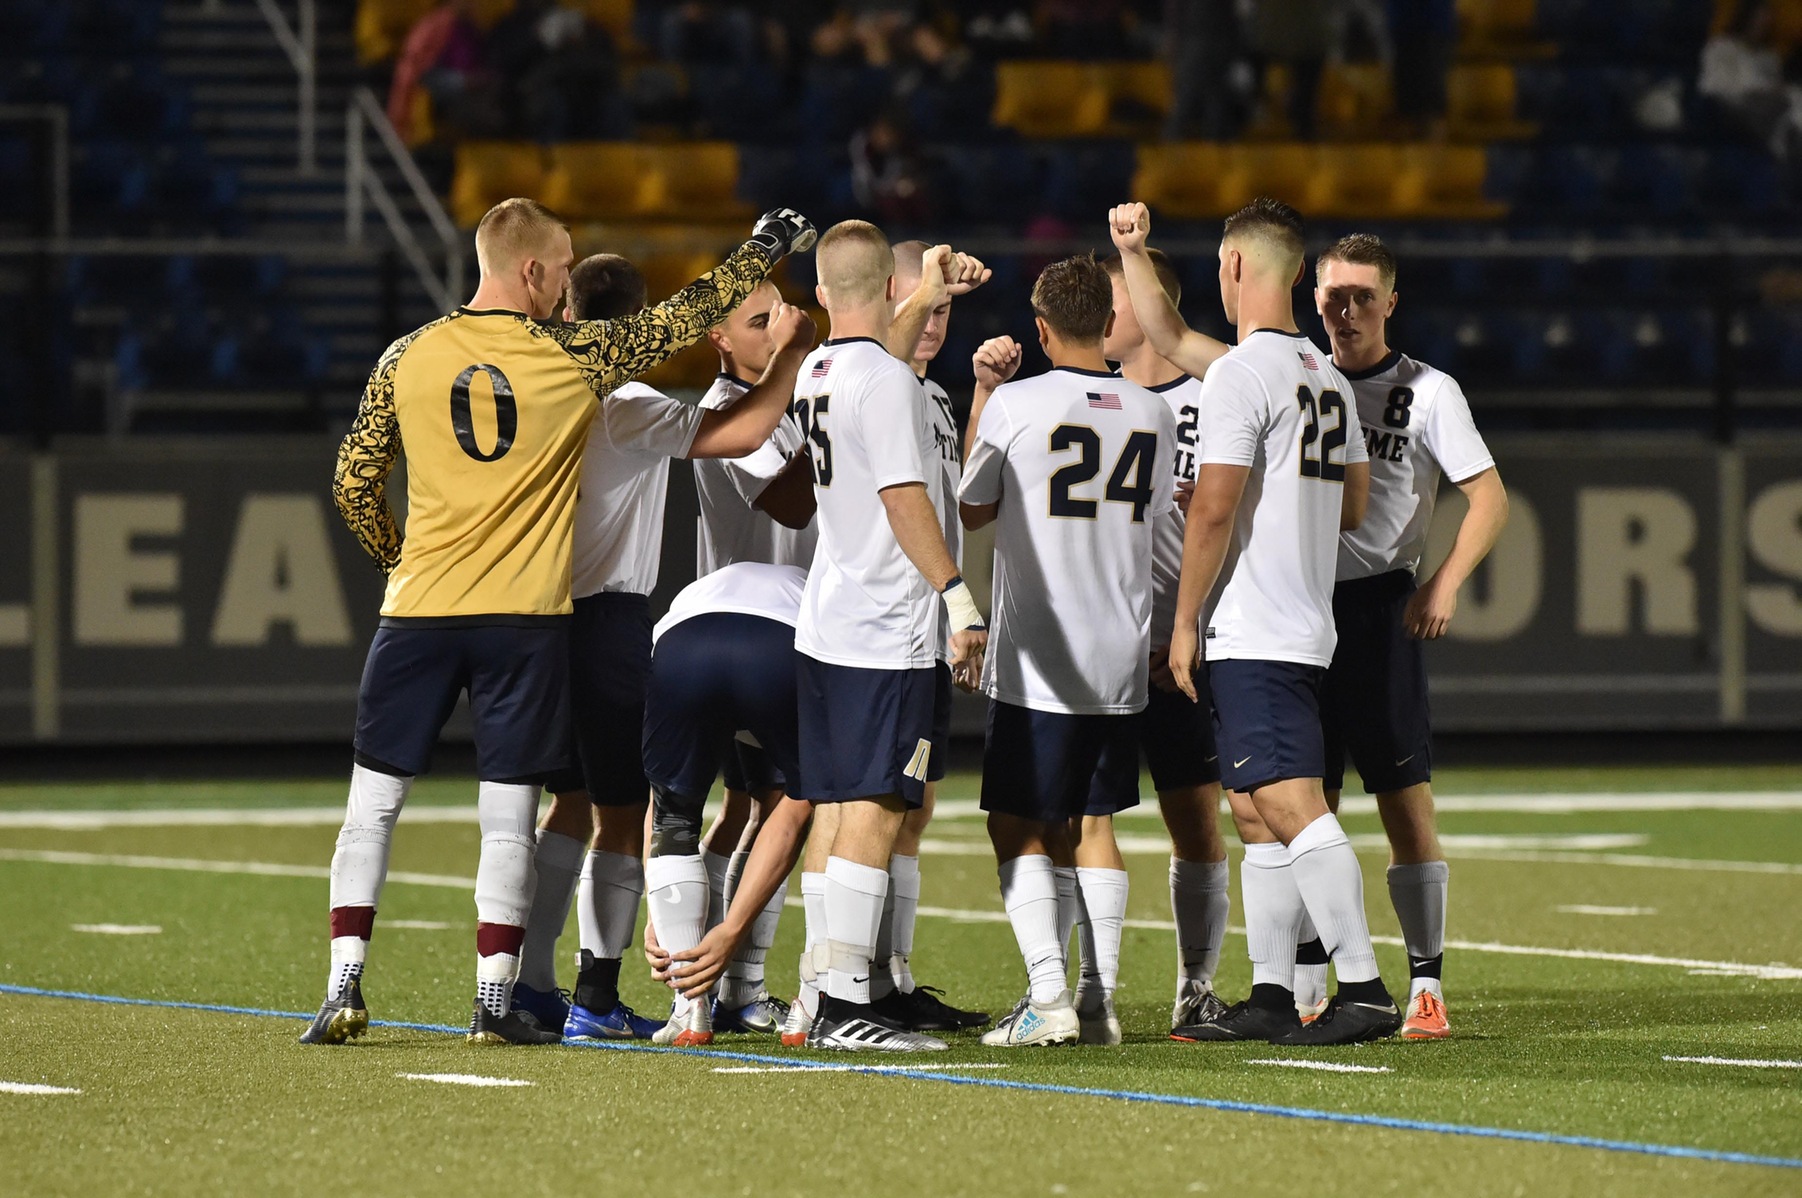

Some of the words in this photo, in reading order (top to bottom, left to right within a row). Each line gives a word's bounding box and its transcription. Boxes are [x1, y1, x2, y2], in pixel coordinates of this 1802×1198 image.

[450, 363, 518, 463] 0
[1176, 404, 1200, 447] 2
[1296, 381, 1347, 485] 22
[1382, 385, 1415, 430] 8
[1047, 421, 1159, 525] 24
[1015, 1016, 1047, 1041] adidas
